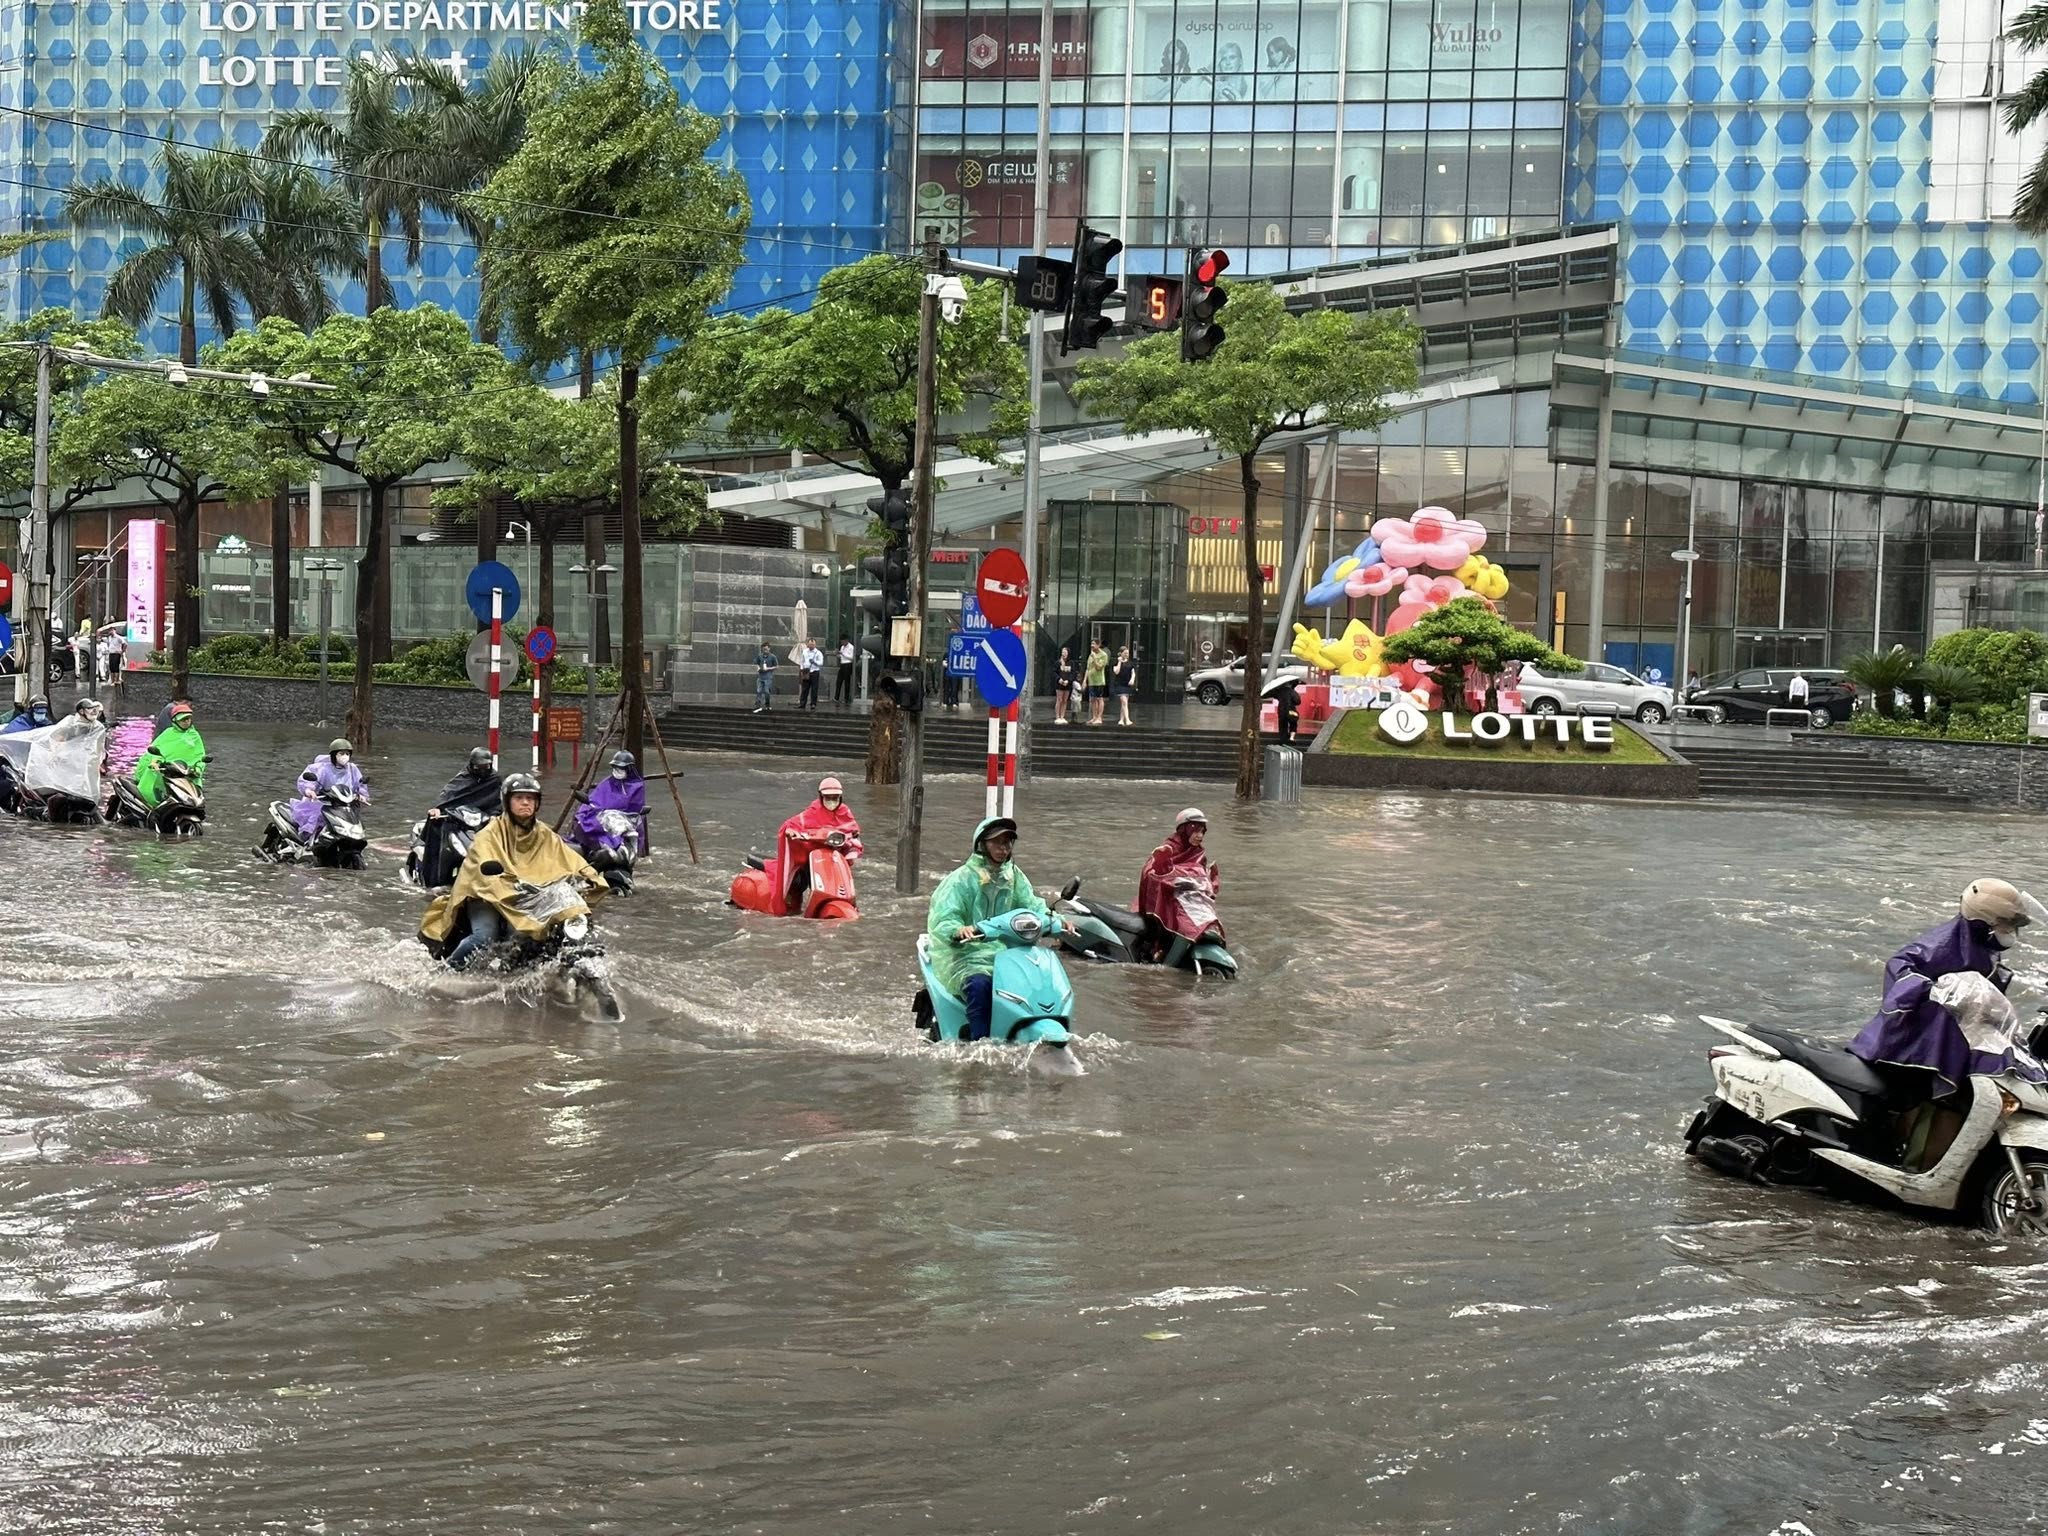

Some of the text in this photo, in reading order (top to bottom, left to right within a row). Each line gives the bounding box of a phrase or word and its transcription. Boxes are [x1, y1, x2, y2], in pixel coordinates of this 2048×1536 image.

[199, 1, 342, 32] LOTTE
[626, 1, 722, 31] TORE
[1227, 22, 1274, 34] airwap
[1426, 22, 1502, 43] Wulao
[199, 56, 342, 87] LOTTE
[987, 163, 1053, 177] MEIWI
[1151, 288, 1166, 320] 5
[1188, 517, 1243, 535] OTT
[1247, 728, 1254, 739] 2
[1442, 711, 1615, 744] LOTTE
